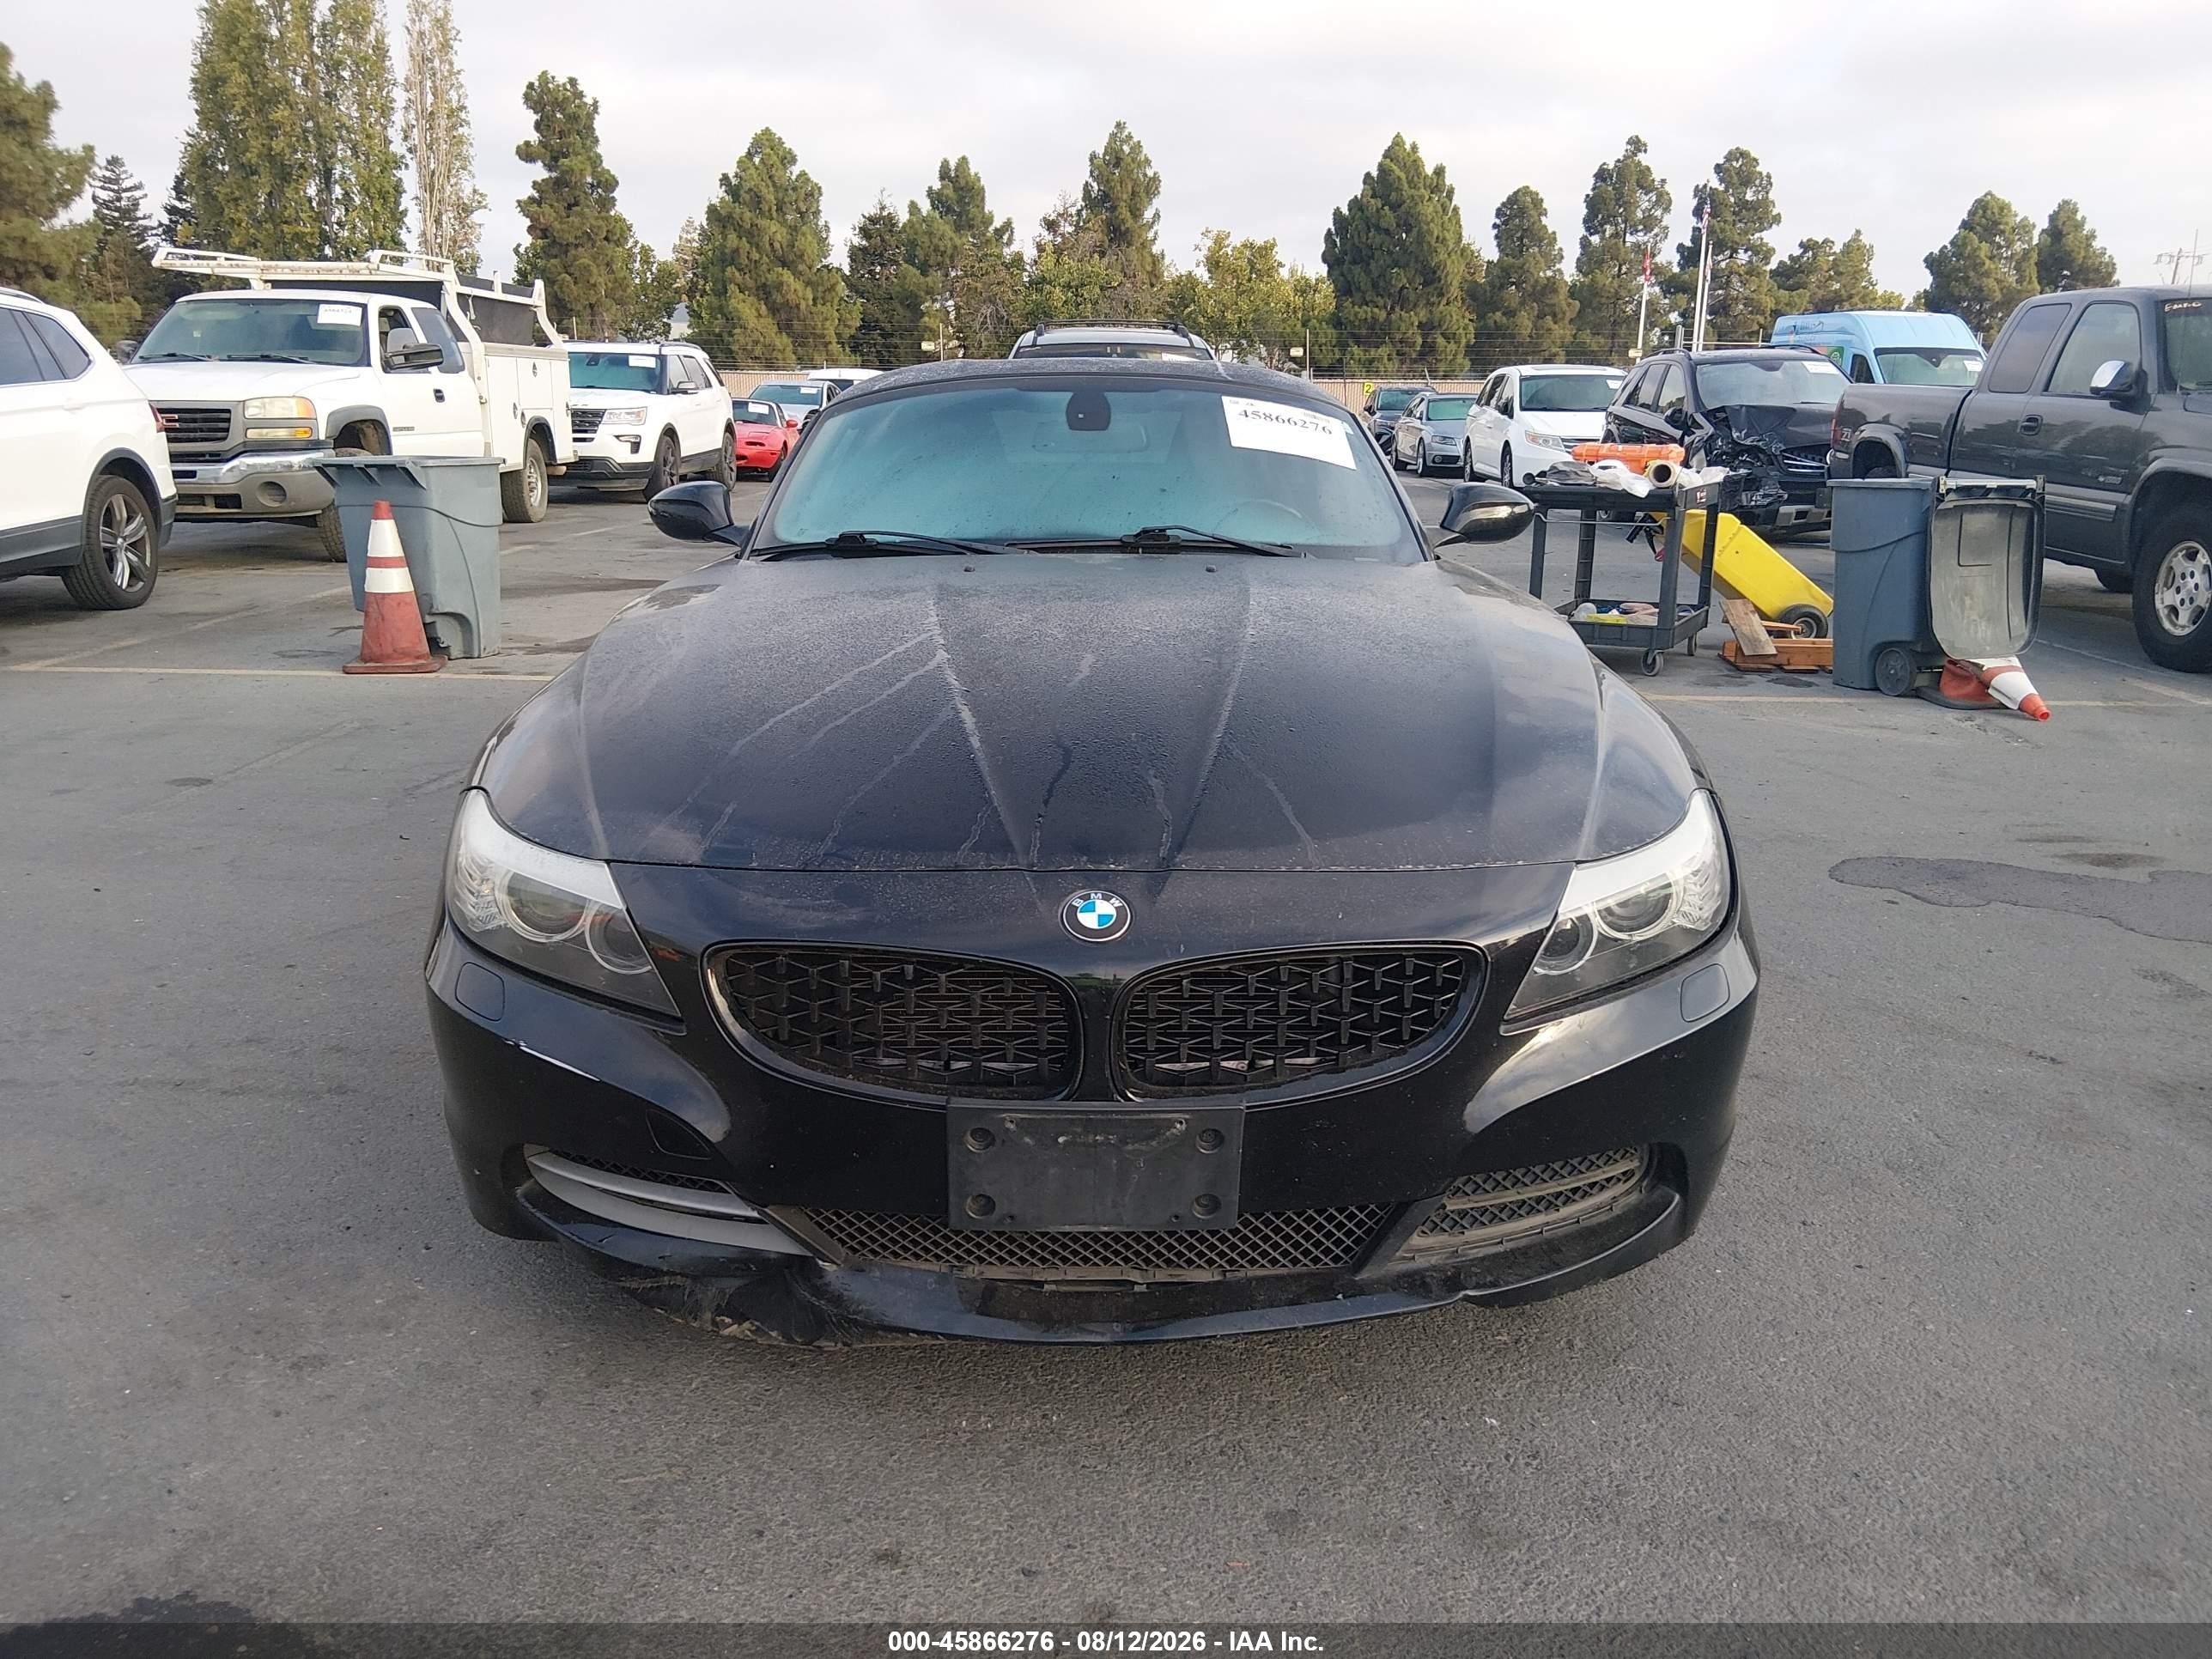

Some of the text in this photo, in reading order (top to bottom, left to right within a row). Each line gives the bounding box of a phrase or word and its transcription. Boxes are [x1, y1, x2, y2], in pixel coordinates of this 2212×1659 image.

[1365, 384, 1372, 394] 2
[1238, 410, 1333, 434] 45866276
[1071, 892, 1124, 908] BMW
